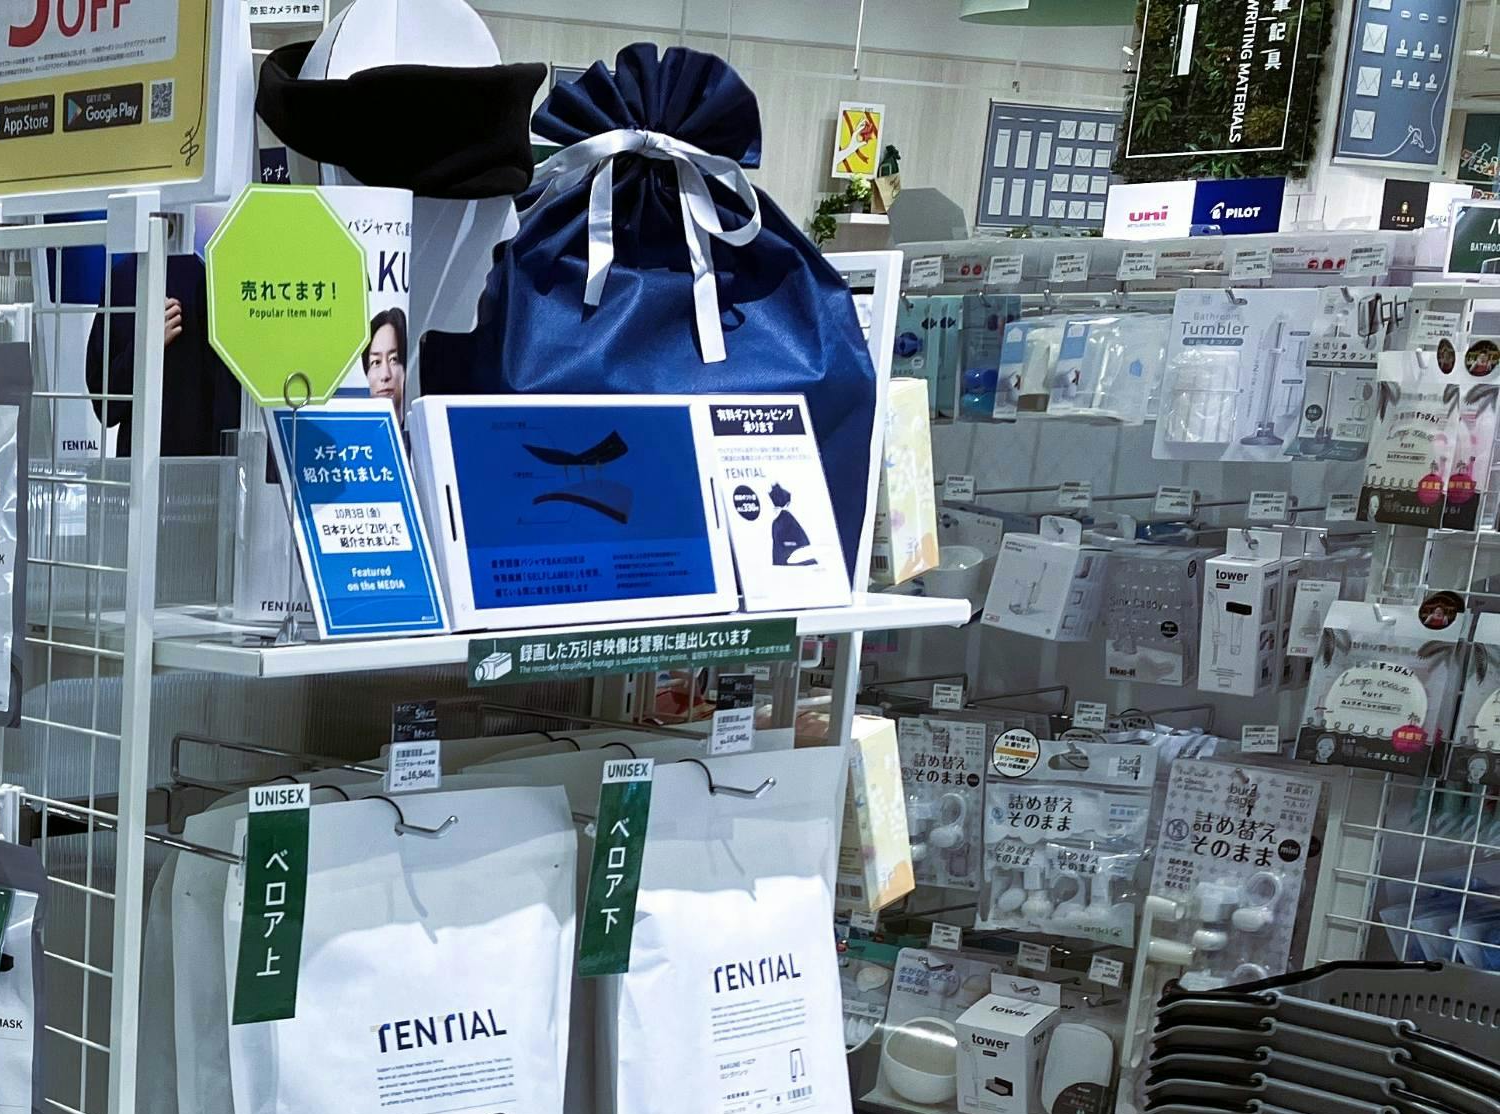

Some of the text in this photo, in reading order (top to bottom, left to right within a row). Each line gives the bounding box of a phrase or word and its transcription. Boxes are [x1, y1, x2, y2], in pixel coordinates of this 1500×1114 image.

[250, 5, 320, 15] 防犯カメラ作動中
[1229, 63, 1252, 143] MATERIALS
[86, 103, 139, 122] Google Play
[3, 114, 49, 135] App Store
[262, 166, 290, 182] やす
[1128, 206, 1169, 222] uni
[1225, 207, 1261, 219] PILOT
[249, 308, 332, 319] Popular Item Now!
[1180, 321, 1250, 336] Tumbler
[63, 440, 99, 450] TENTIAL
[314, 445, 373, 461] メディアで
[303, 467, 395, 484] 紹介されました
[724, 467, 766, 480] TENTIAL
[340, 536, 400, 548] 紹介されました
[351, 566, 391, 578] Featured
[1216, 568, 1248, 582] tower
[347, 578, 405, 591] on the MEDIA
[260, 600, 311, 613] TENTIAL
[519, 629, 751, 663] 録画した万引き映像は警察に提出しています
[914, 752, 967, 770] 詰め替え
[607, 764, 648, 778] UNISEX
[914, 769, 967, 786] そのまま
[254, 788, 304, 806] UNISEX
[1008, 794, 1075, 814] 詰め替え
[1007, 813, 1072, 832] そのまま
[1193, 811, 1277, 845] 詰め替え
[1191, 836, 1274, 867] そのまま
[600, 818, 631, 935] ベロア下
[256, 850, 290, 978] ベロア上
[710, 953, 802, 994] TENTIAL
[990, 1004, 1031, 1018] tower
[370, 1009, 508, 1053] TENTIAL
[971, 1032, 1010, 1051] tower
